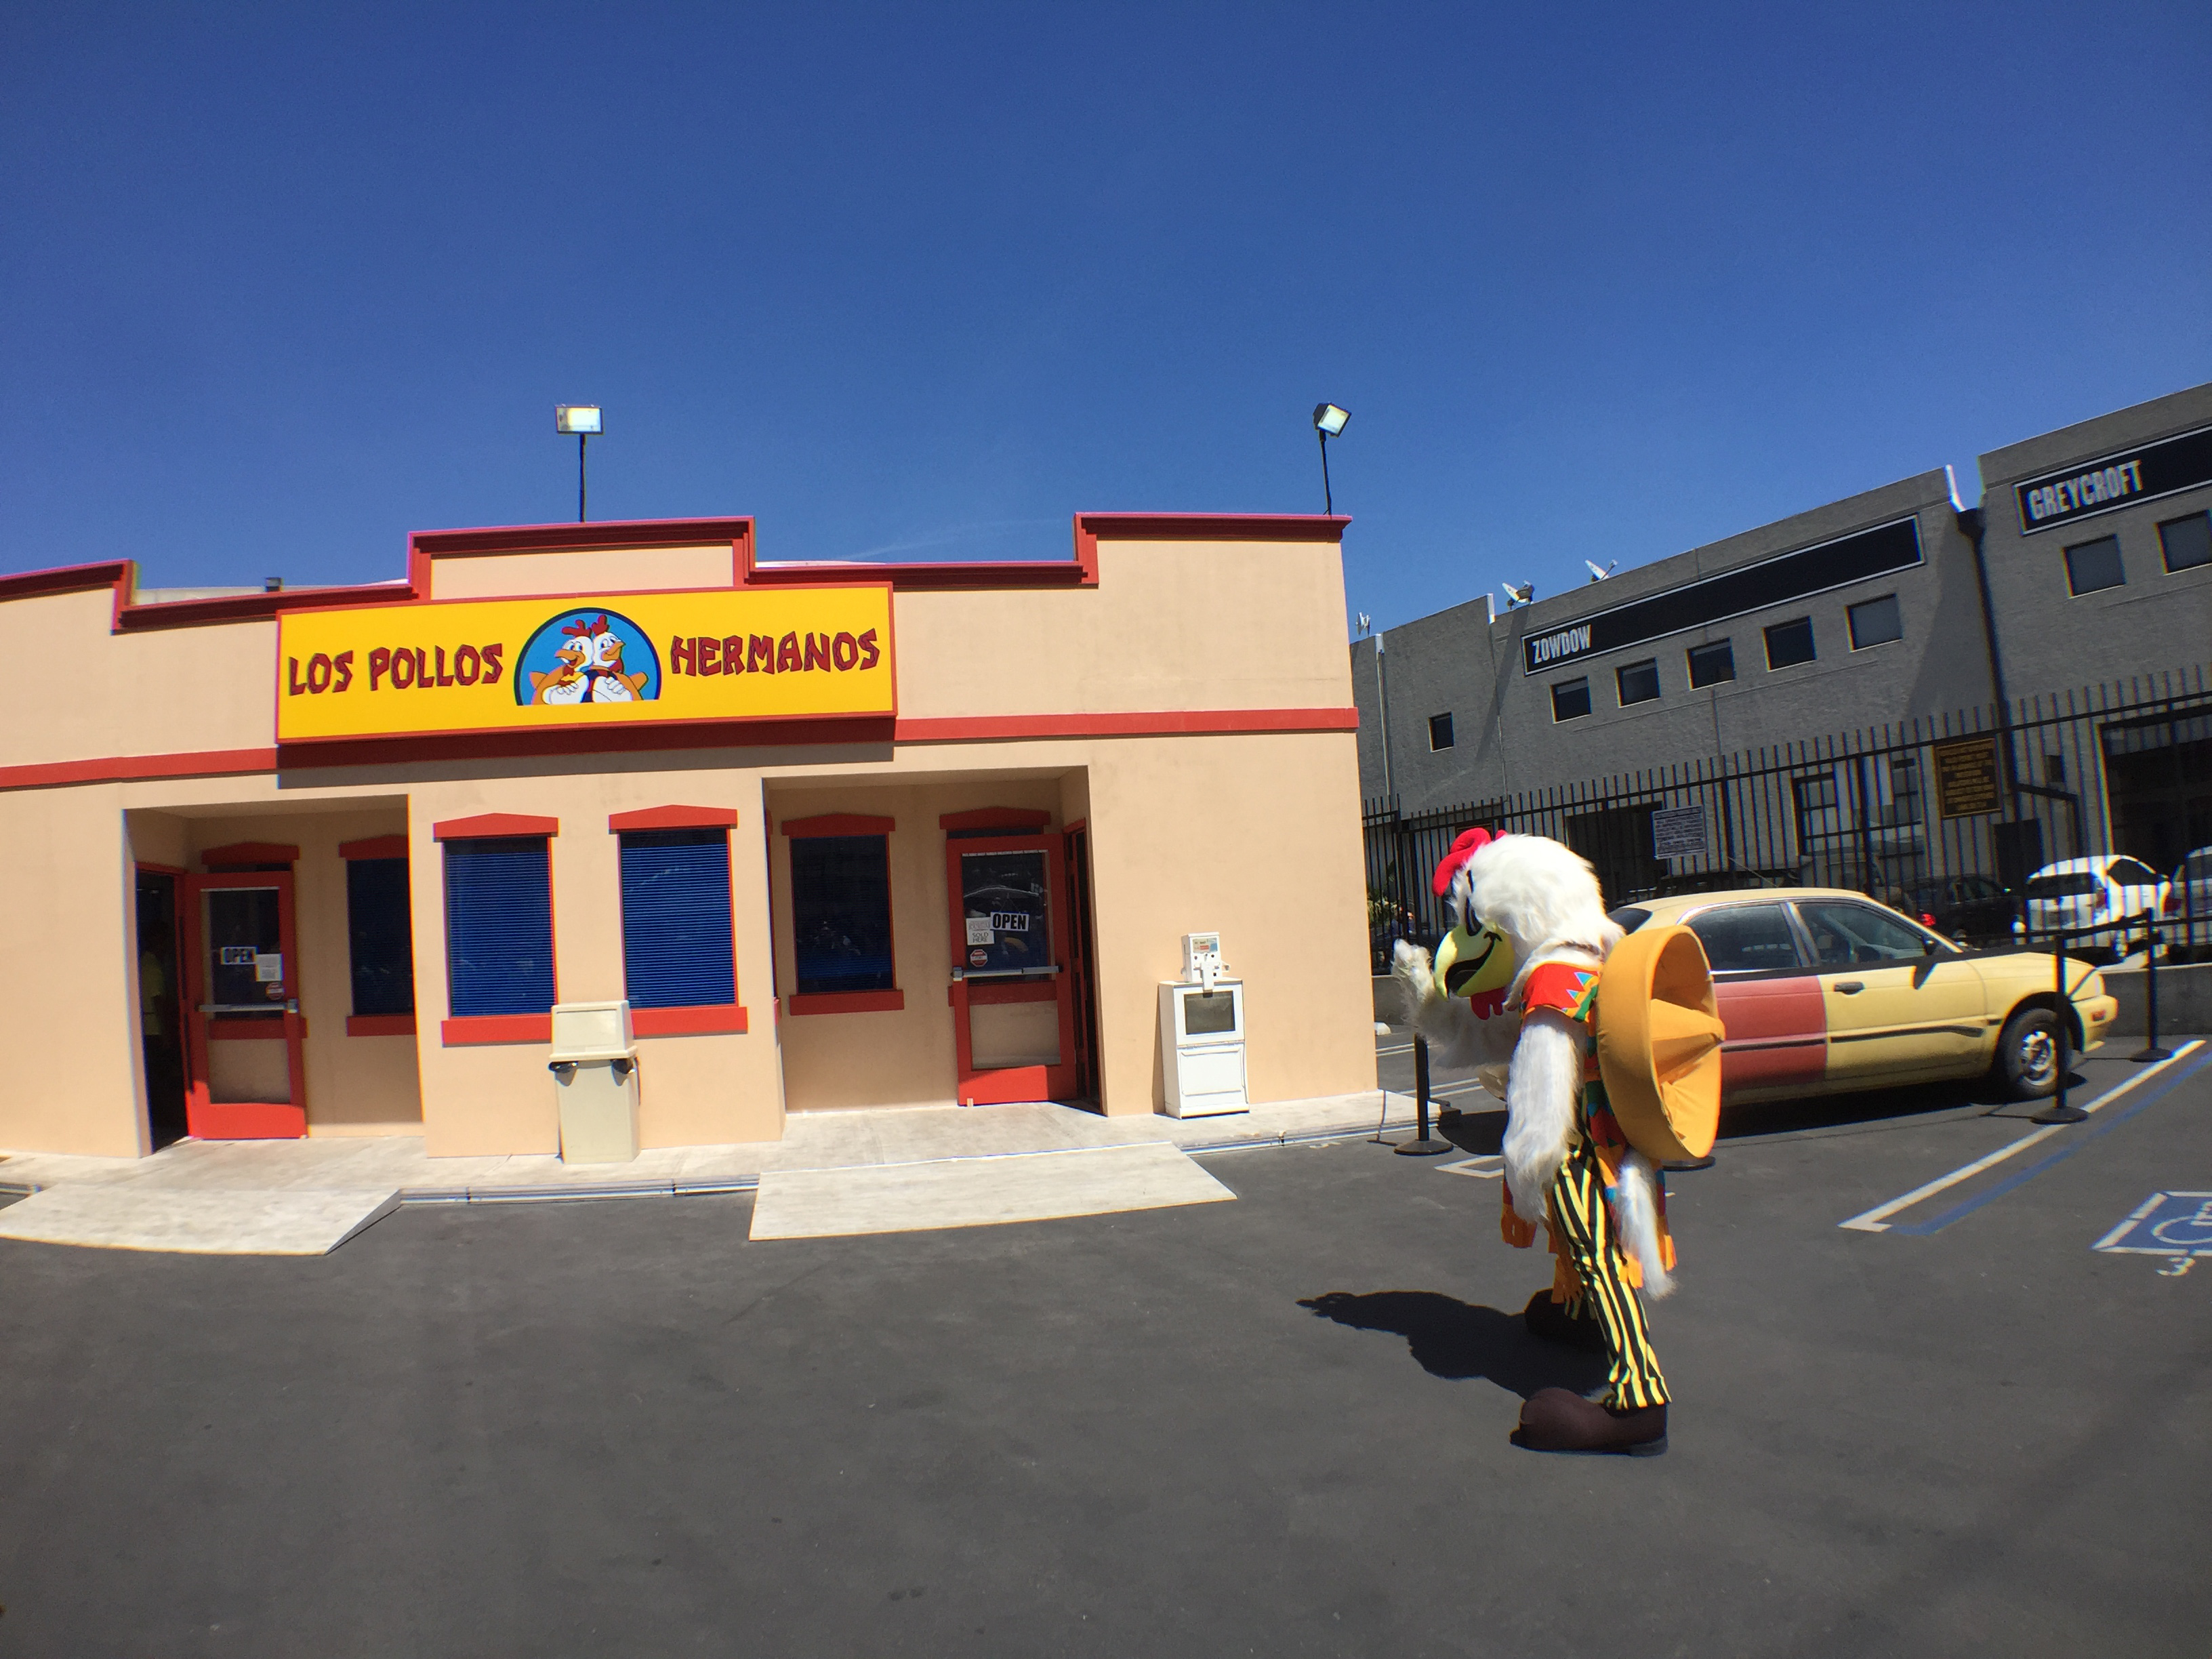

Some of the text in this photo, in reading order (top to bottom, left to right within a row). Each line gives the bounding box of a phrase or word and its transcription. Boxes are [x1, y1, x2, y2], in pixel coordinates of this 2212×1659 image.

[2026, 459, 2144, 520] GREYCROFT
[289, 628, 880, 696] LOS POLLOS HERMANOS
[1531, 624, 1592, 664] ZOWDOW
[992, 914, 1027, 930] OPEN
[224, 948, 255, 963] OPEN
